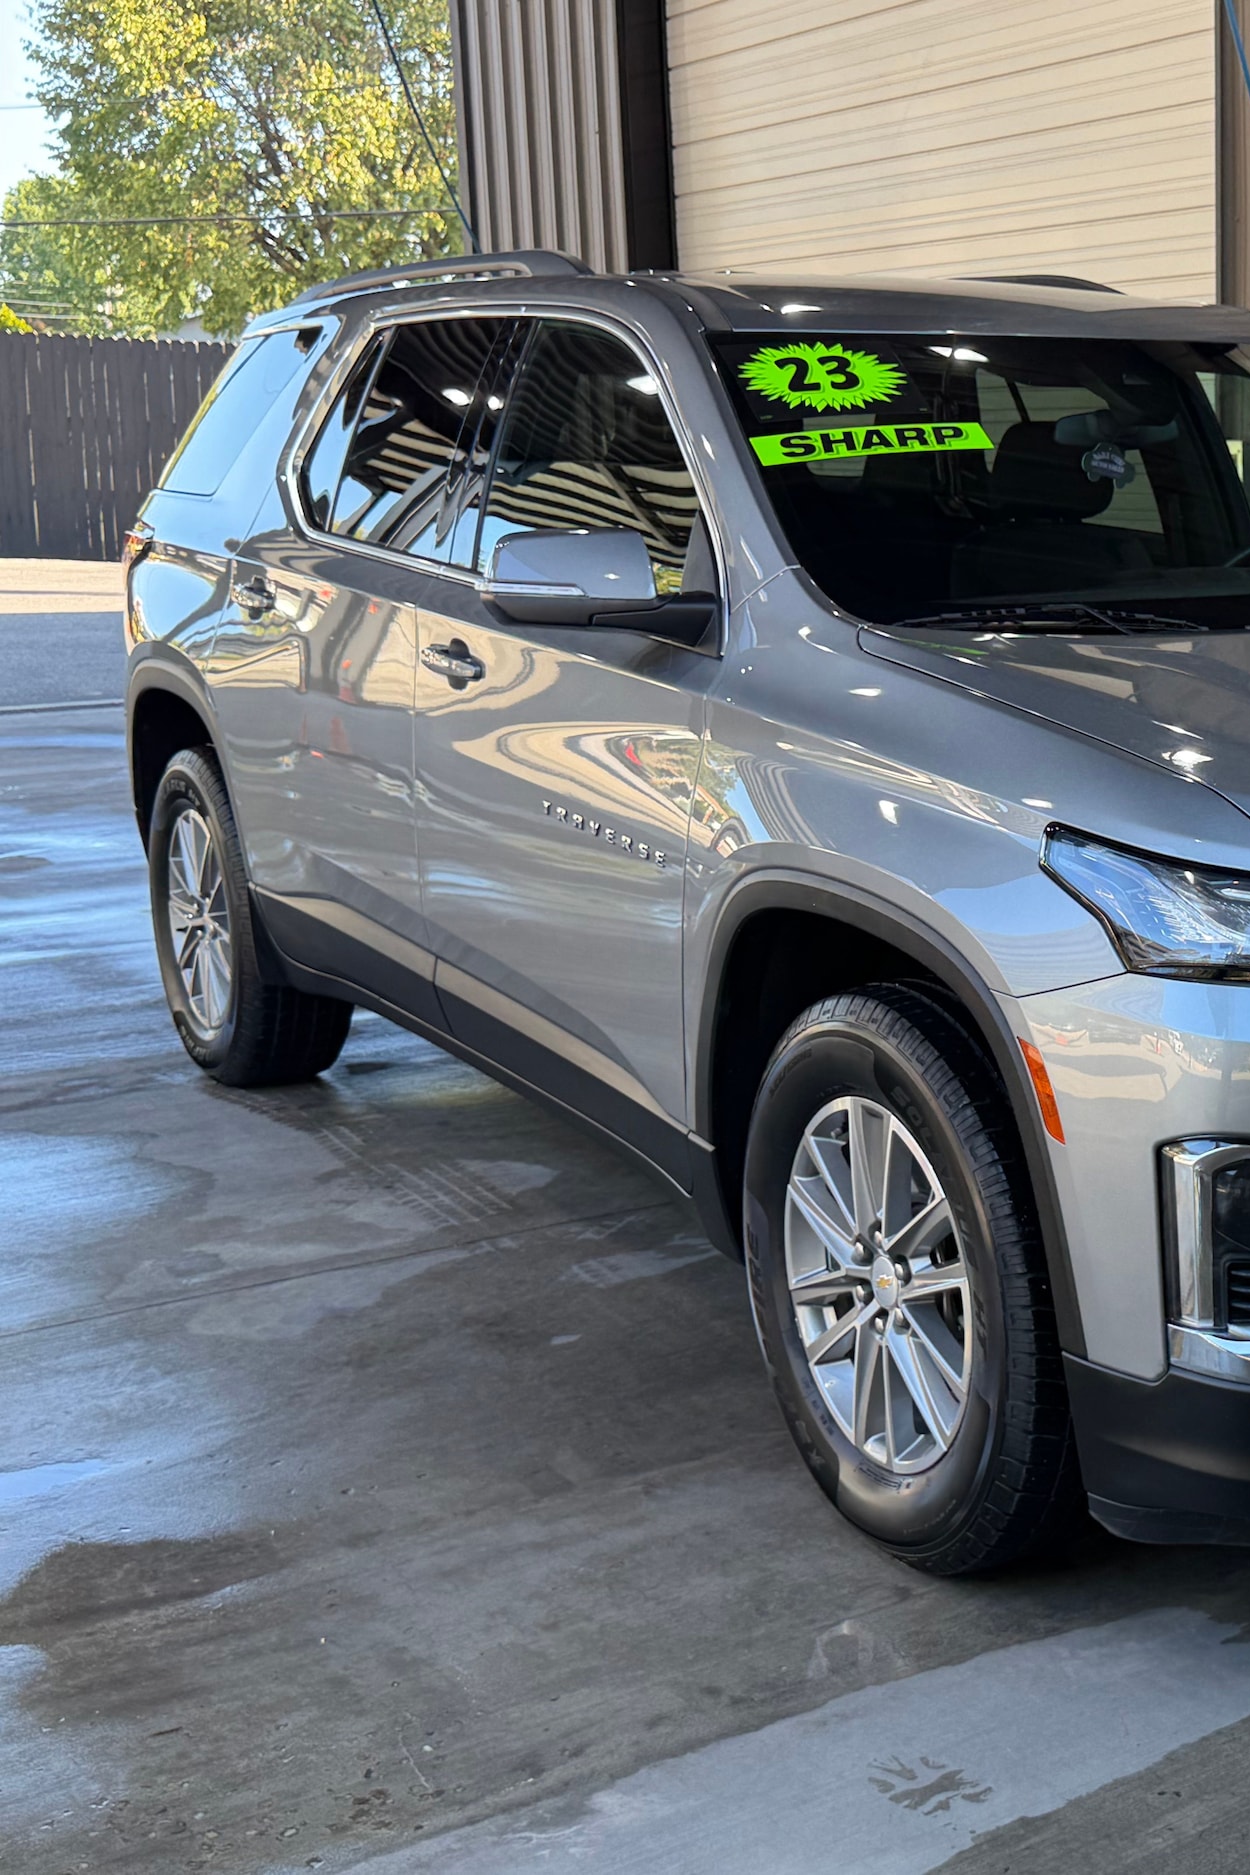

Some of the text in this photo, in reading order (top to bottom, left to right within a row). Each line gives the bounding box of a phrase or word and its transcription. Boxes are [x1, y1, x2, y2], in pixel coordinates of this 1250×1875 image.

[774, 356, 861, 392] 23
[780, 426, 964, 457] SHARP
[542, 799, 667, 868] TRAVERSE
[889, 1085, 979, 1272] SOLUS
